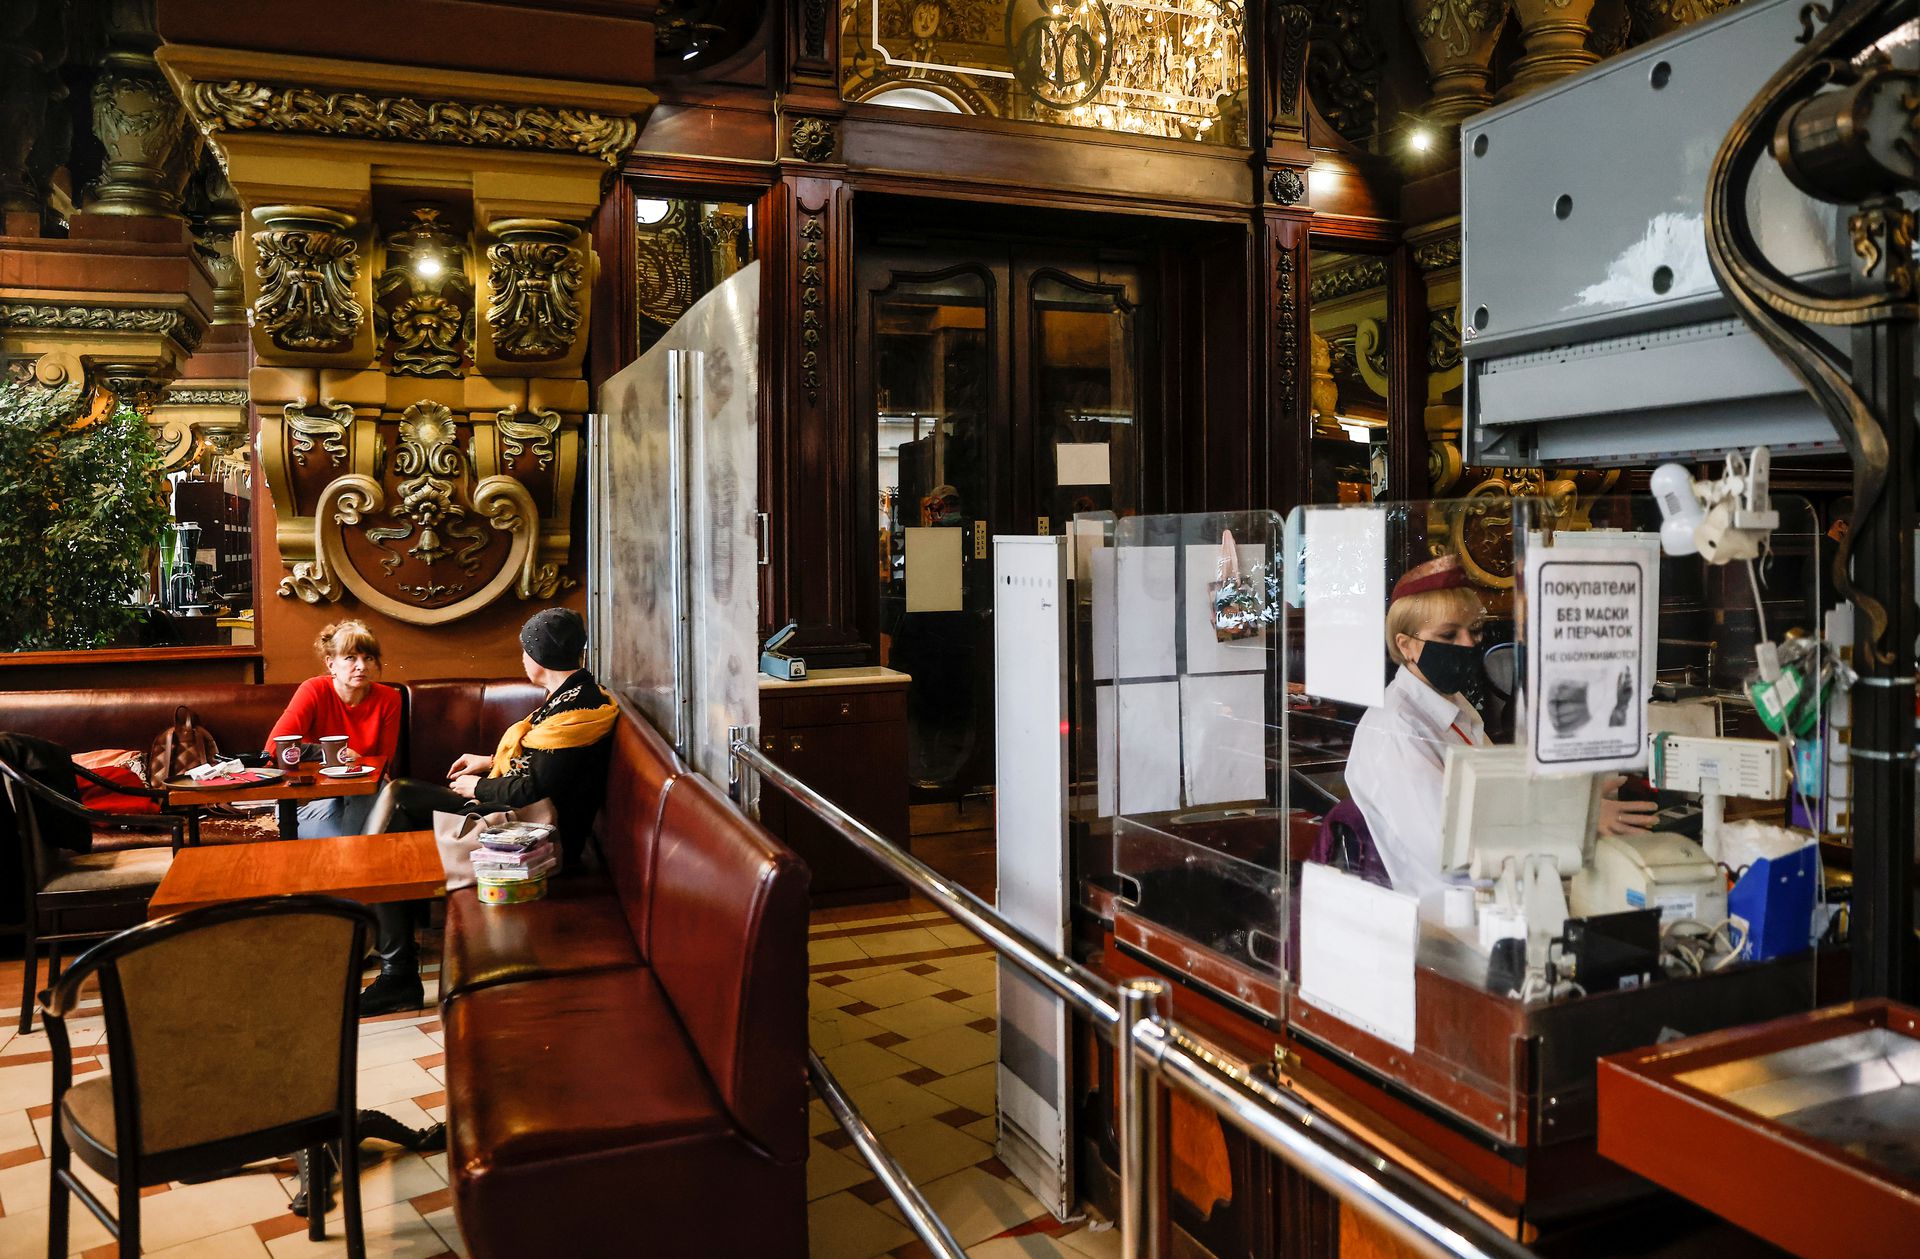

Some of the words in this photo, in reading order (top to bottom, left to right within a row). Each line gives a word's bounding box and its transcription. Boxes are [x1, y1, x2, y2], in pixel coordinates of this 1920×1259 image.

[1557, 607, 1582, 622] БЕЗ
[1585, 606, 1629, 621] МАСКИ
[1554, 627, 1563, 639] И
[1567, 625, 1633, 640] ПЕРЧАТОК
